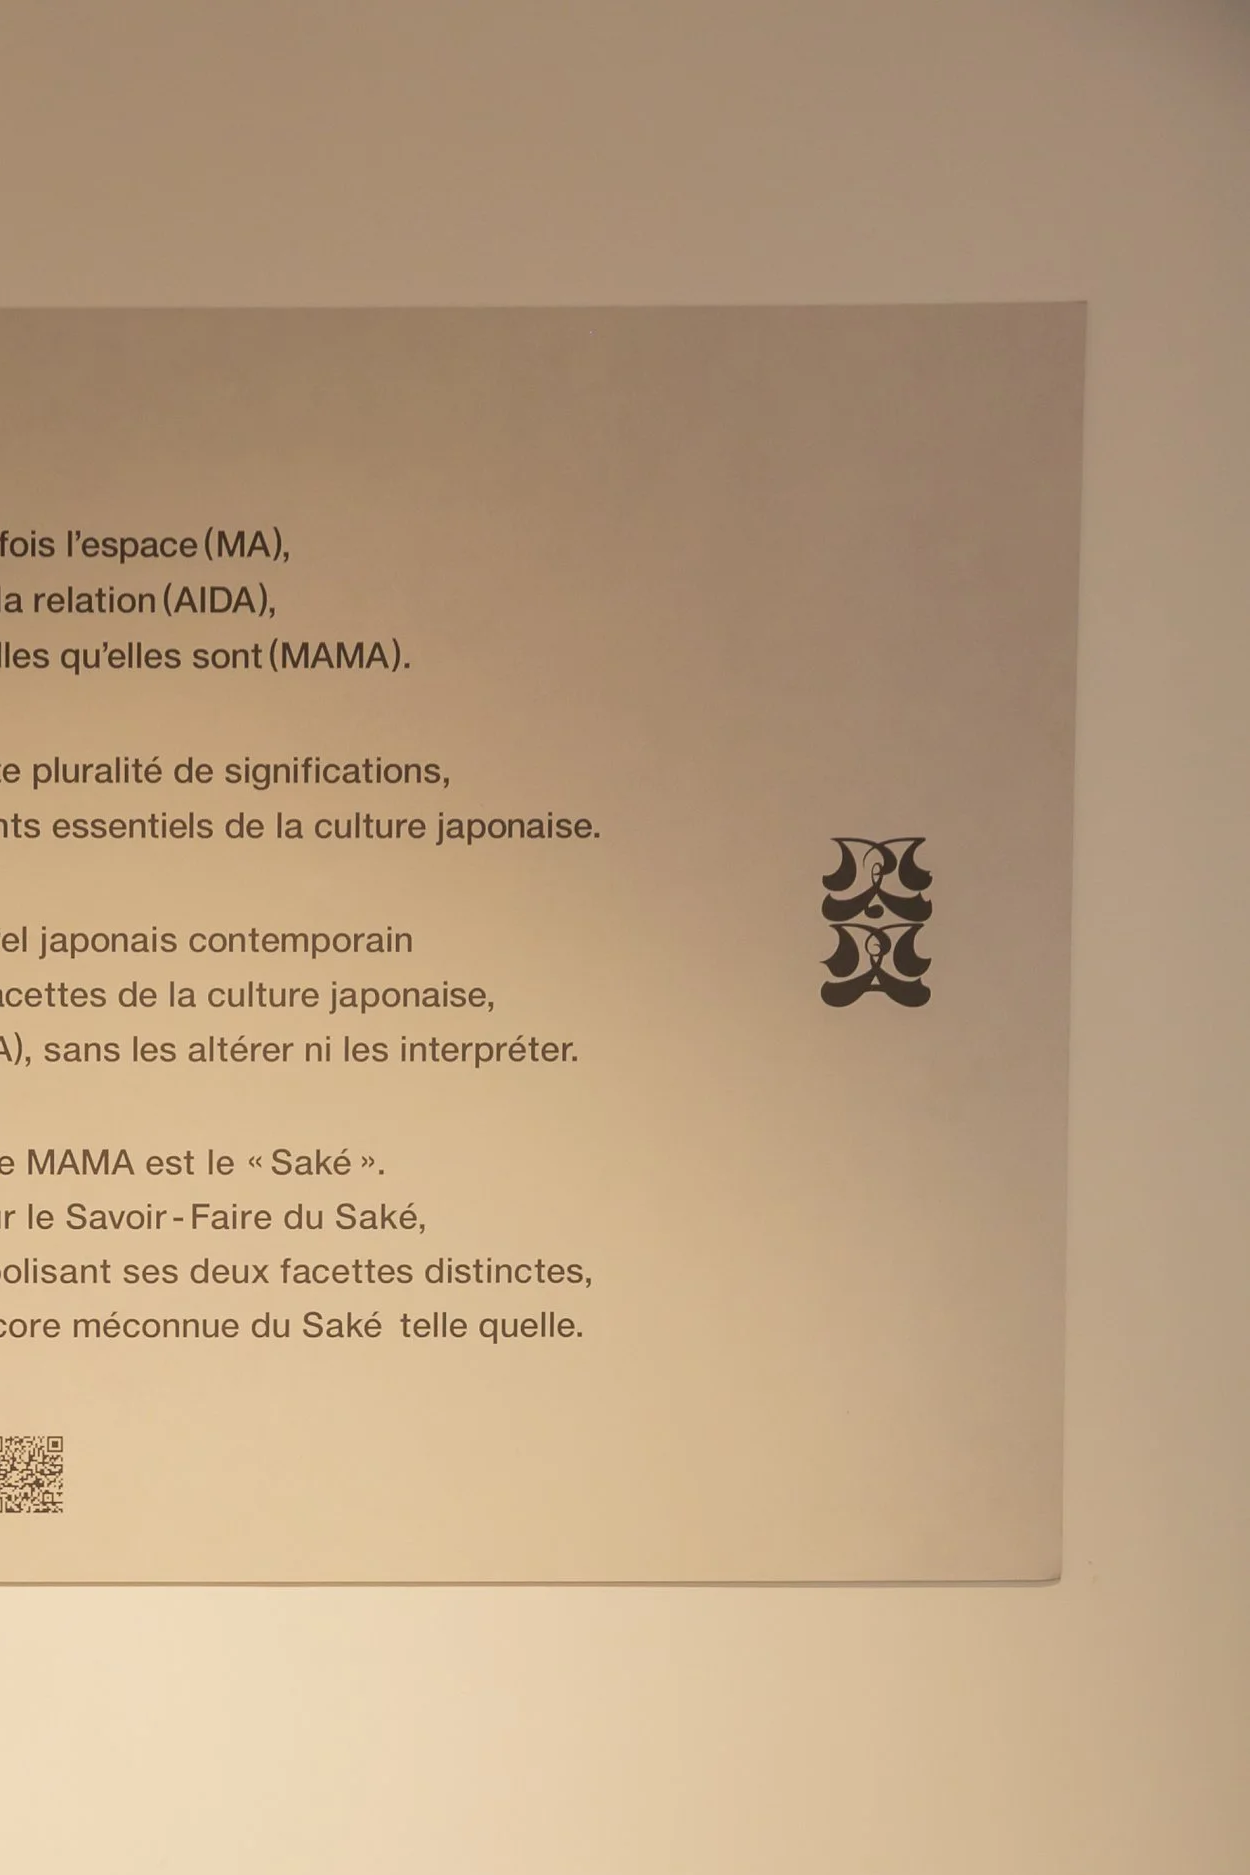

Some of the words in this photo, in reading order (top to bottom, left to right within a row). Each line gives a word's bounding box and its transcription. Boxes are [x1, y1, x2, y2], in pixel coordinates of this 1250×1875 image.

[60, 641, 182, 676] qu'elles
[32, 755, 163, 791] pluralité
[173, 756, 214, 785] de
[224, 756, 450, 791] significations,
[52, 811, 214, 840] essentiels
[224, 811, 265, 840] de
[276, 811, 304, 840] la
[314, 811, 427, 840] culture
[435, 811, 601, 847] japonaise.
[38, 925, 178, 961] japonais
[188, 925, 413, 960] contemporain
[118, 980, 158, 1008] de
[169, 980, 197, 1008] la
[207, 980, 320, 1008] culture
[328, 980, 494, 1015] japonaise,
[43, 1041, 121, 1063] sans
[132, 1035, 177, 1063] les
[187, 1034, 295, 1063] altérer
[305, 1035, 331, 1063] ni
[344, 1035, 389, 1063] les
[400, 1034, 578, 1069] interpréter.
[27, 1148, 135, 1176] MAMA
[145, 1150, 195, 1176] est
[208, 1148, 235, 1176] le
[27, 1202, 55, 1230] le
[283, 1202, 323, 1230] du
[335, 1202, 426, 1235] Saké,
[122, 1263, 179, 1285] ses
[189, 1257, 270, 1285] deux
[279, 1257, 414, 1285] facettes
[424, 1256, 592, 1289] distinctes,
[73, 1310, 240, 1339] méconnue
[251, 1311, 290, 1339] du
[302, 1310, 383, 1339] Saké
[399, 1311, 468, 1339] telle
[478, 1310, 583, 1345] quelle.
